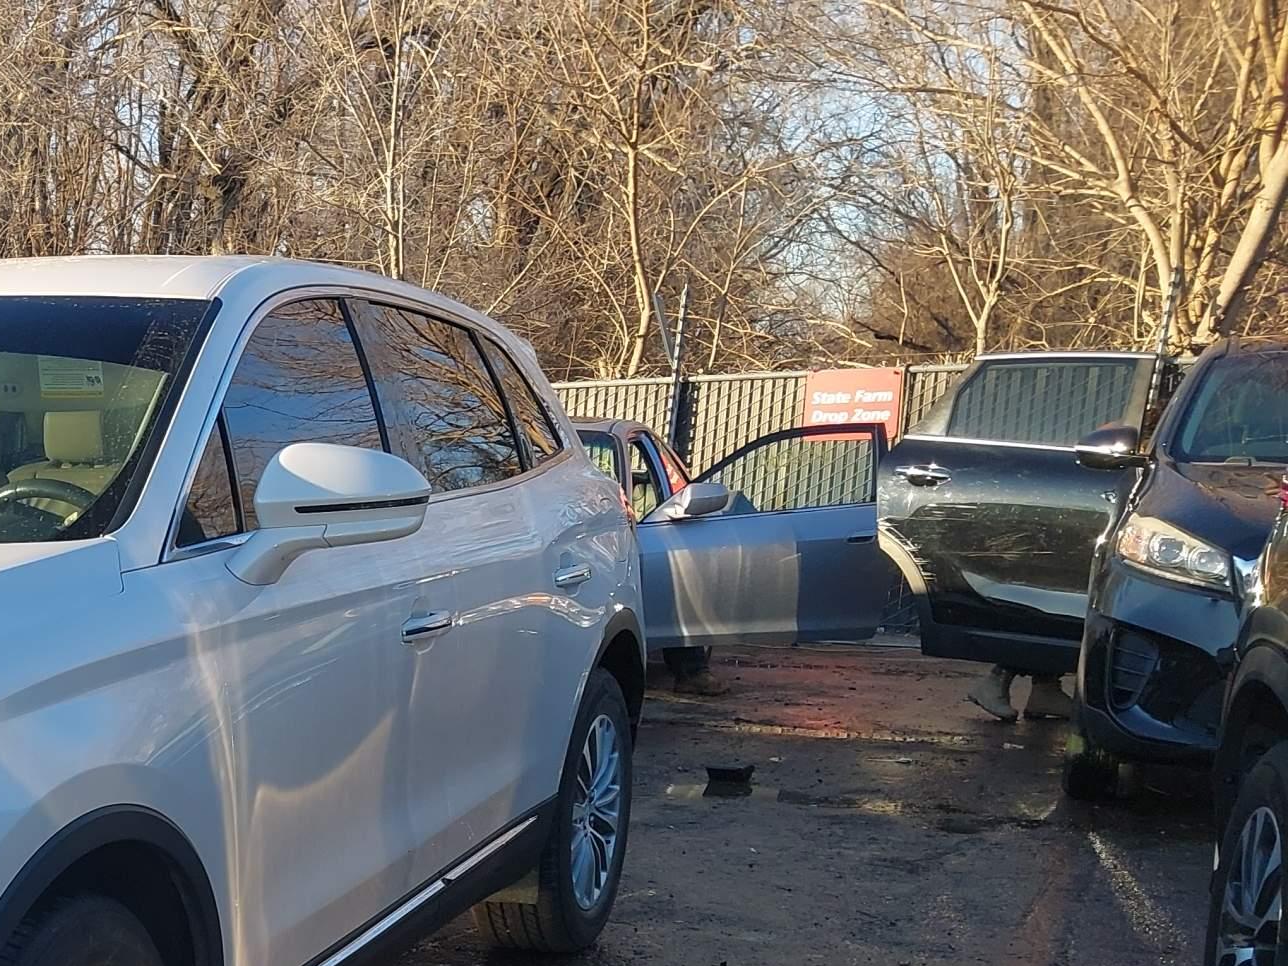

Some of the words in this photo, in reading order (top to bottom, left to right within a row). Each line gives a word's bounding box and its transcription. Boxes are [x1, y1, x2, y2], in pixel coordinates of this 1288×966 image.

[812, 391, 851, 405] State
[854, 389, 893, 403] Farm
[812, 409, 849, 423] Drop
[850, 408, 891, 421] Zone
